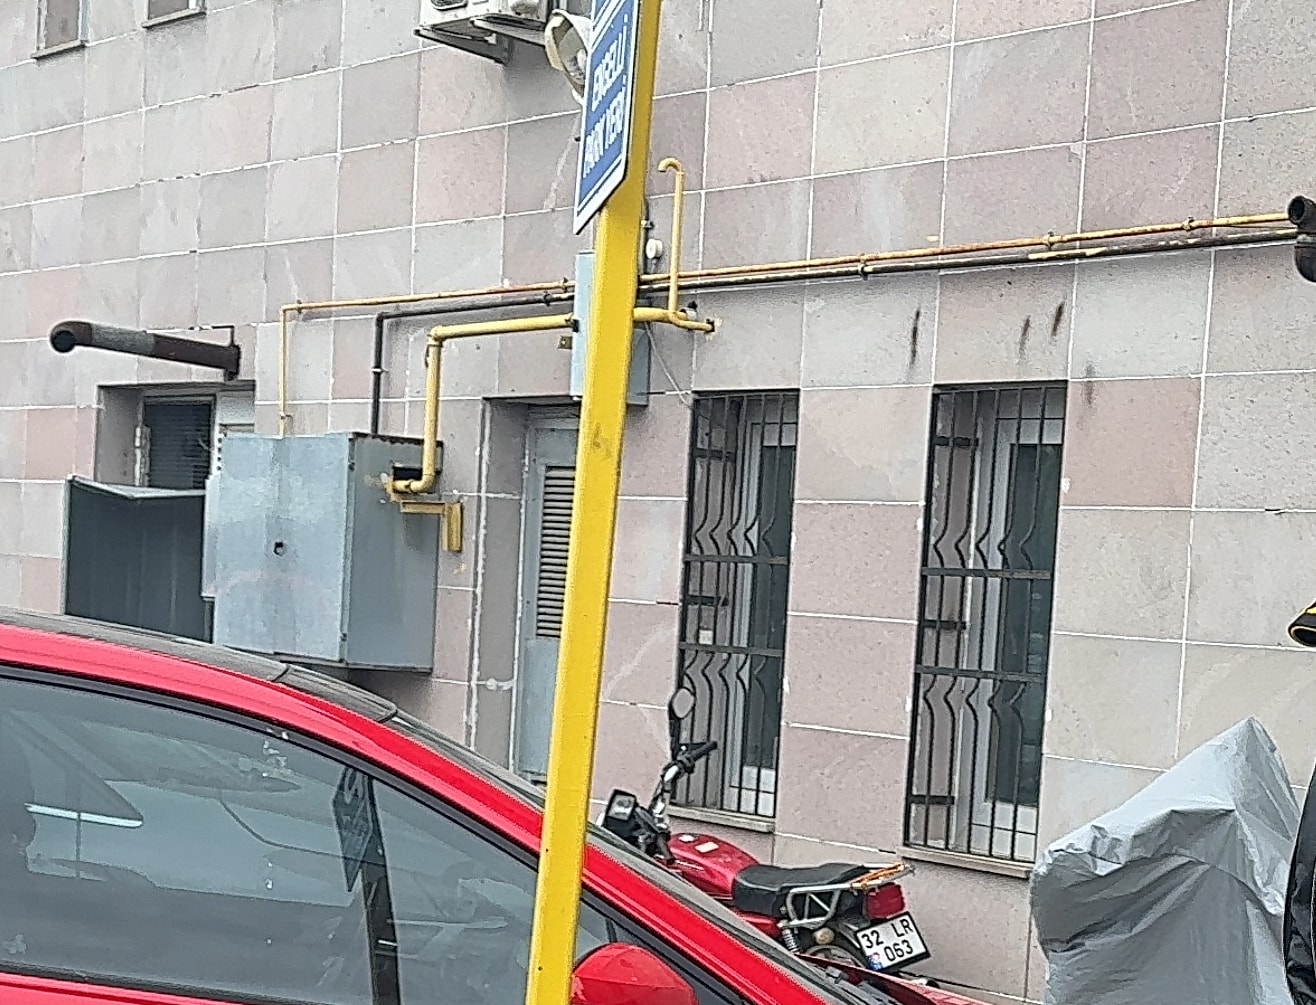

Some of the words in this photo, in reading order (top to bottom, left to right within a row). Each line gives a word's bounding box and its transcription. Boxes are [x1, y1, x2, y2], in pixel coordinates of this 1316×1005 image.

[861, 929, 884, 949] 32
[890, 918, 914, 938] LR
[883, 939, 914, 962] 063
